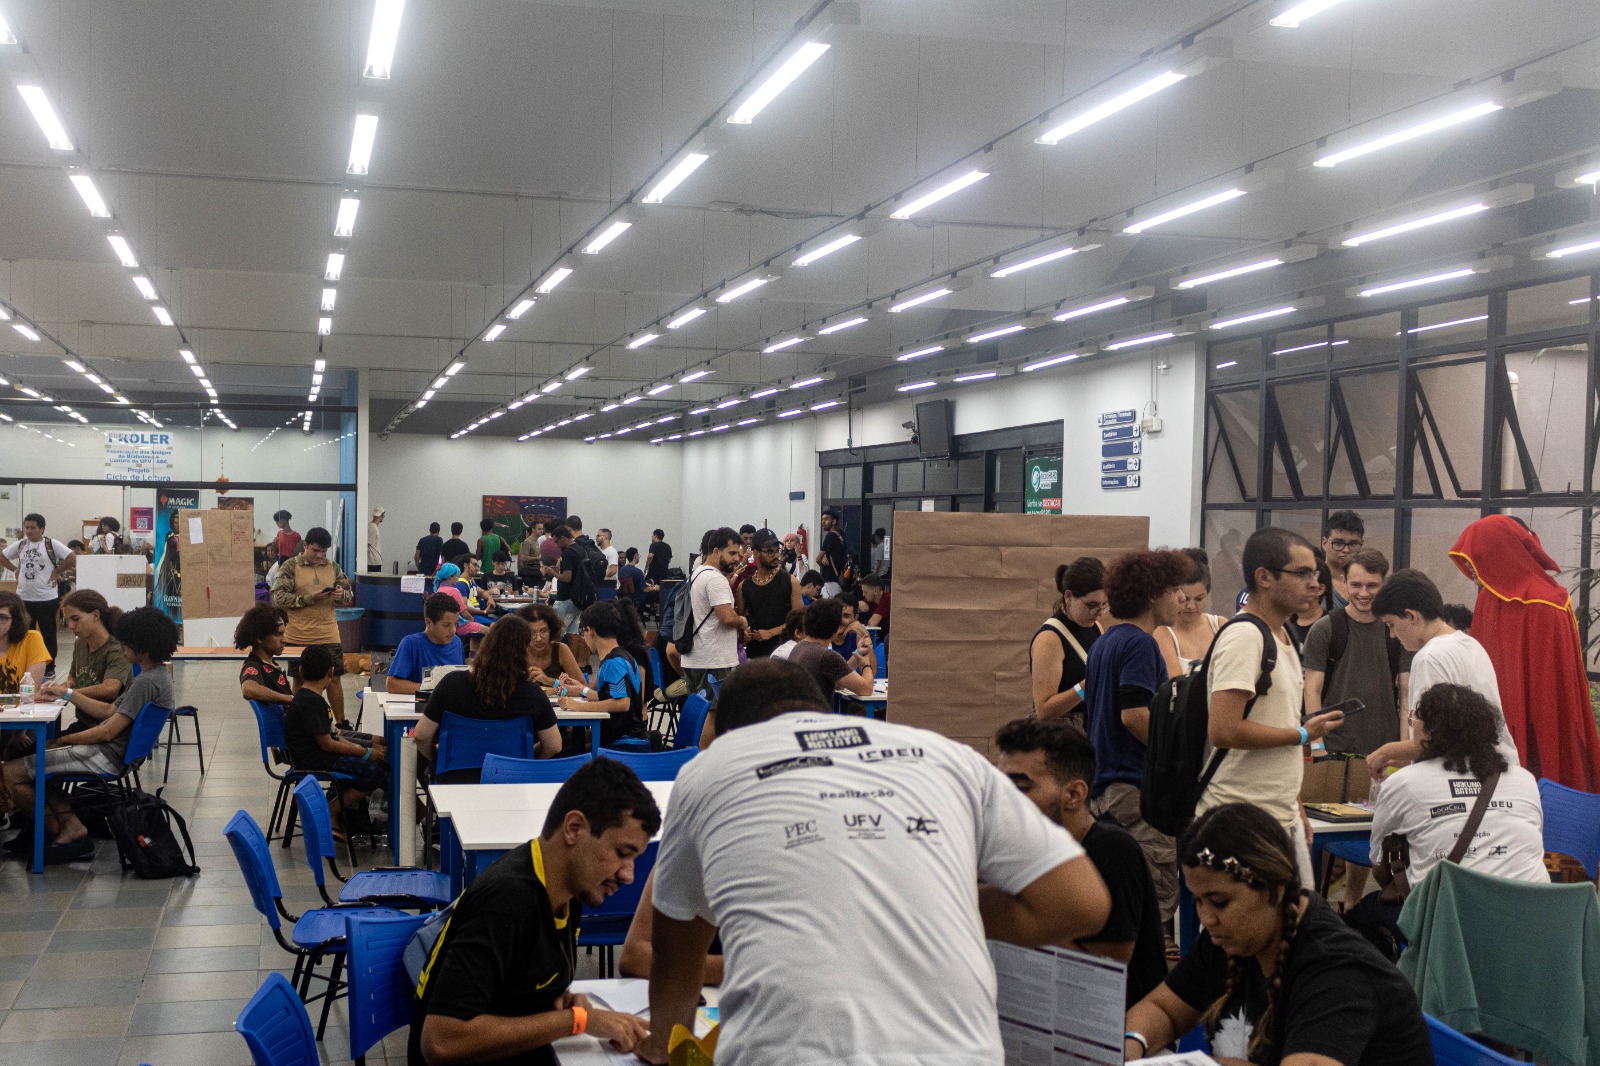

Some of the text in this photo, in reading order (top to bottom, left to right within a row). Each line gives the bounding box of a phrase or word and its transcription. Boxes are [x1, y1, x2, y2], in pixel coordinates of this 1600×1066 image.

[109, 434, 169, 444] PROLER
[106, 473, 128, 481] Ciclo
[167, 497, 195, 506] MAGIC
[803, 728, 859, 742] HAKUNA
[858, 747, 923, 761] ICBEU
[820, 790, 894, 800] Realização
[844, 814, 882, 827] UFV
[784, 820, 817, 839] PEC
